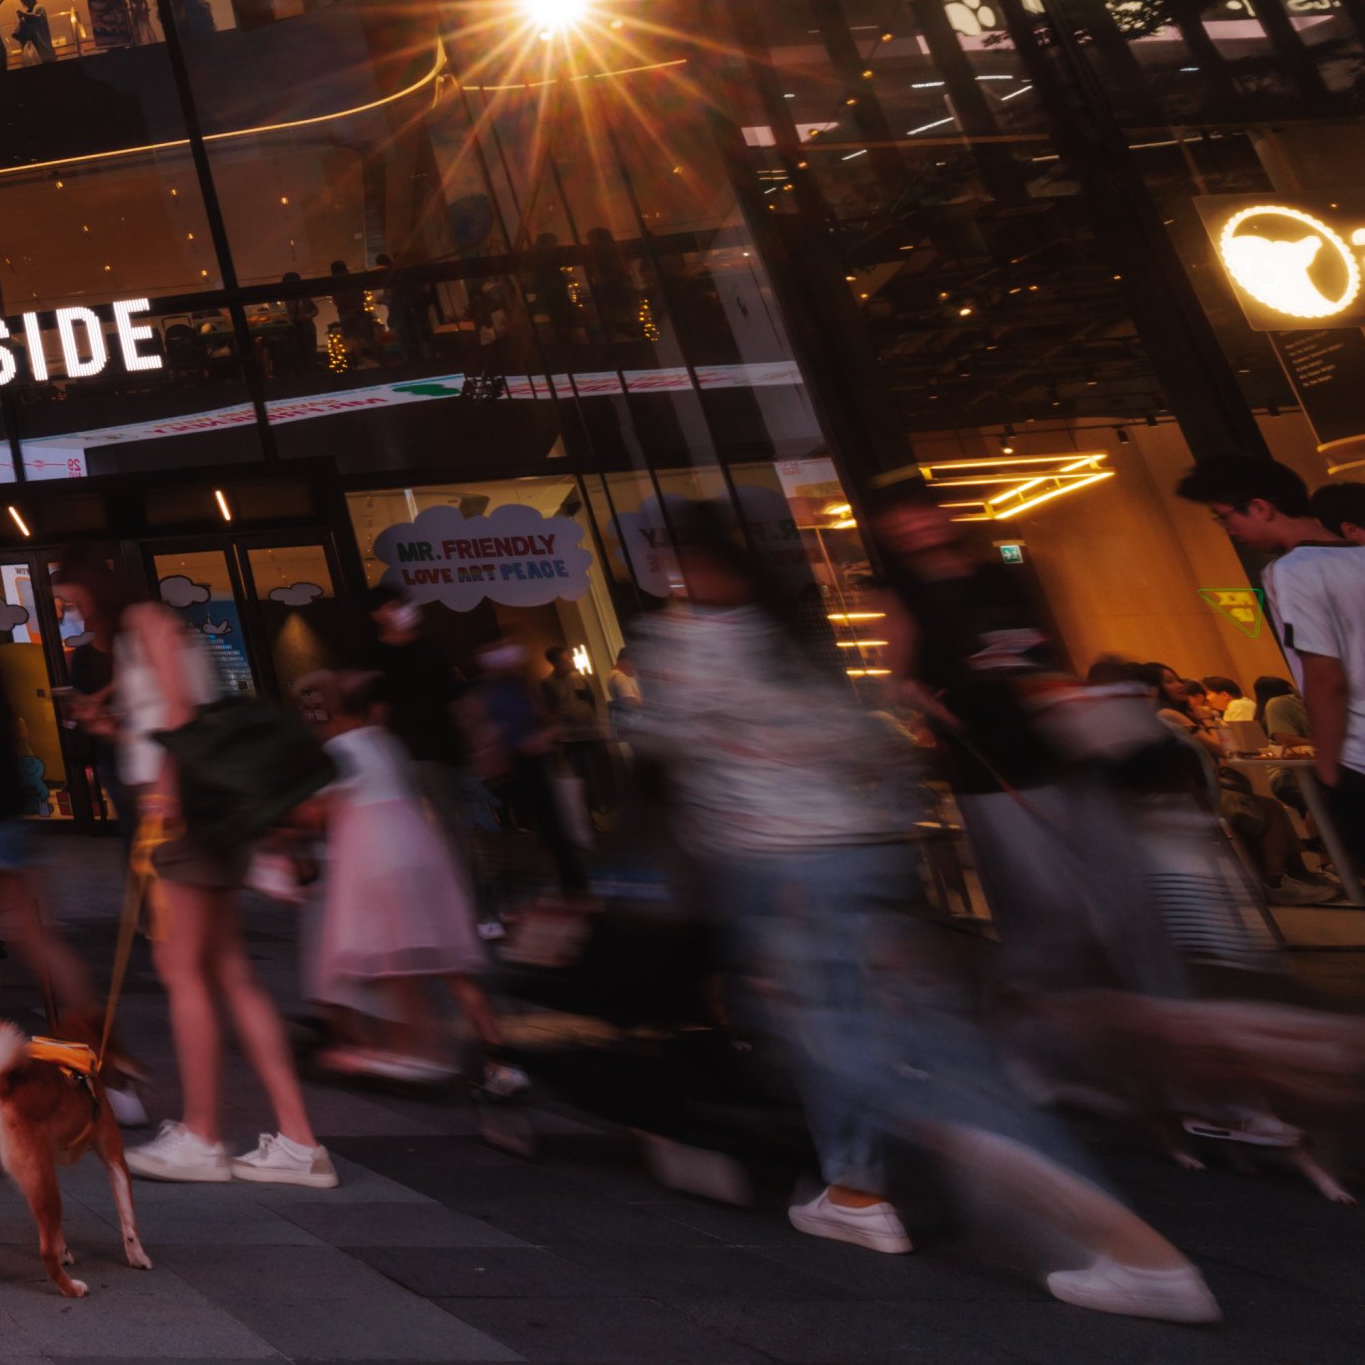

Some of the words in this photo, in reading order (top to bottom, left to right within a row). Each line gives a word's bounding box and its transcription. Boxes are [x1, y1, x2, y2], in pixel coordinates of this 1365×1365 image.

[402, 568, 452, 586] LOVE
[457, 564, 495, 582] ART
[500, 559, 569, 581] PEACE
